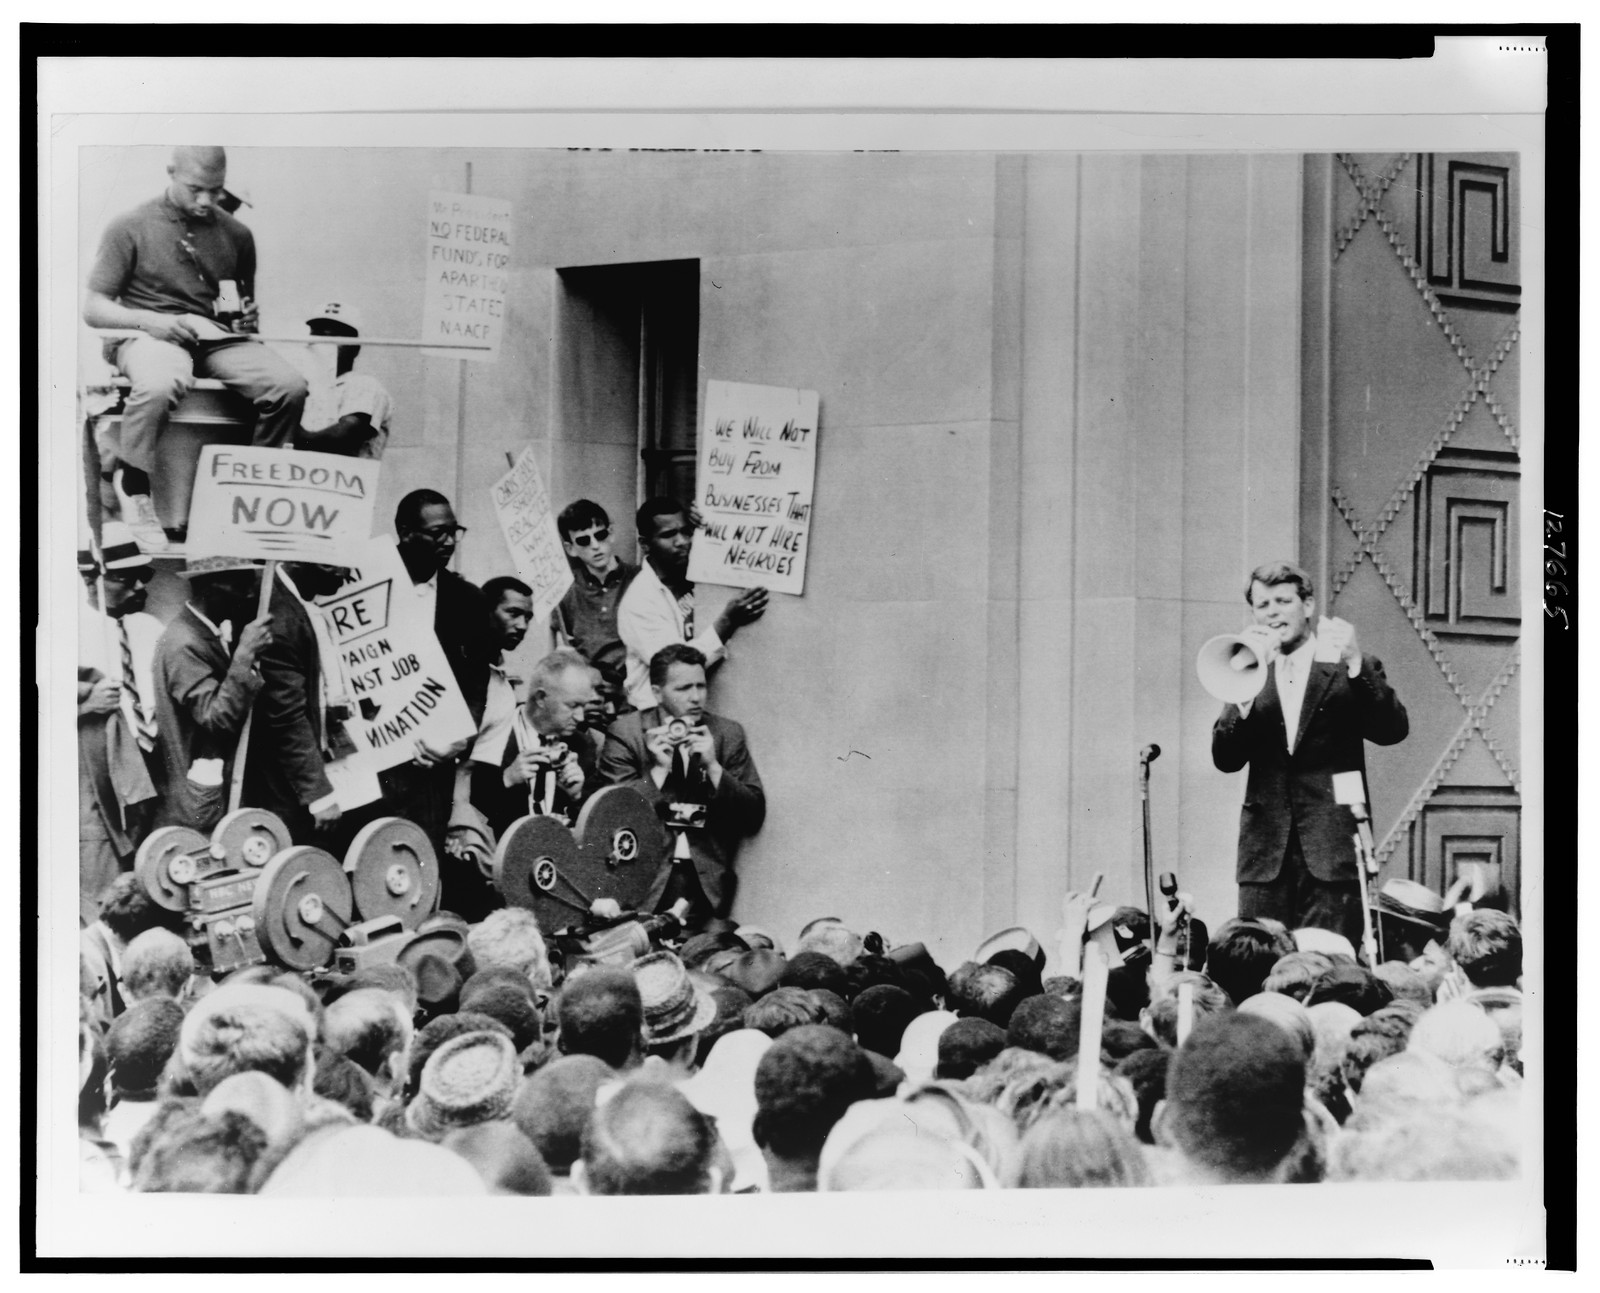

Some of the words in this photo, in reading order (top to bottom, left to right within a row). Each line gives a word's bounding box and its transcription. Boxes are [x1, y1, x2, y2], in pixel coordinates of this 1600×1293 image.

[430, 221, 451, 237] NO
[456, 224, 510, 246] FEDERAL
[432, 245, 483, 267] FUNDS
[443, 294, 502, 318] STATES
[440, 320, 490, 339] NAACP
[716, 417, 735, 438] WE
[742, 416, 772, 440] WILL
[779, 418, 810, 442] NOT
[211, 453, 366, 496] FREEDOM
[709, 447, 735, 475] BUY
[742, 451, 782, 475] FROM
[232, 495, 340, 531] NOW
[705, 483, 782, 513] BUSINESSES
[787, 492, 810, 521] THAT
[704, 522, 727, 541] WILL
[733, 526, 768, 544] NOT
[769, 525, 803, 552] HIRE
[724, 546, 795, 576] NEGROES
[331, 599, 372, 635] RE
[342, 638, 392, 667] AIGN
[350, 667, 383, 695] NST
[391, 653, 420, 681] JOB
